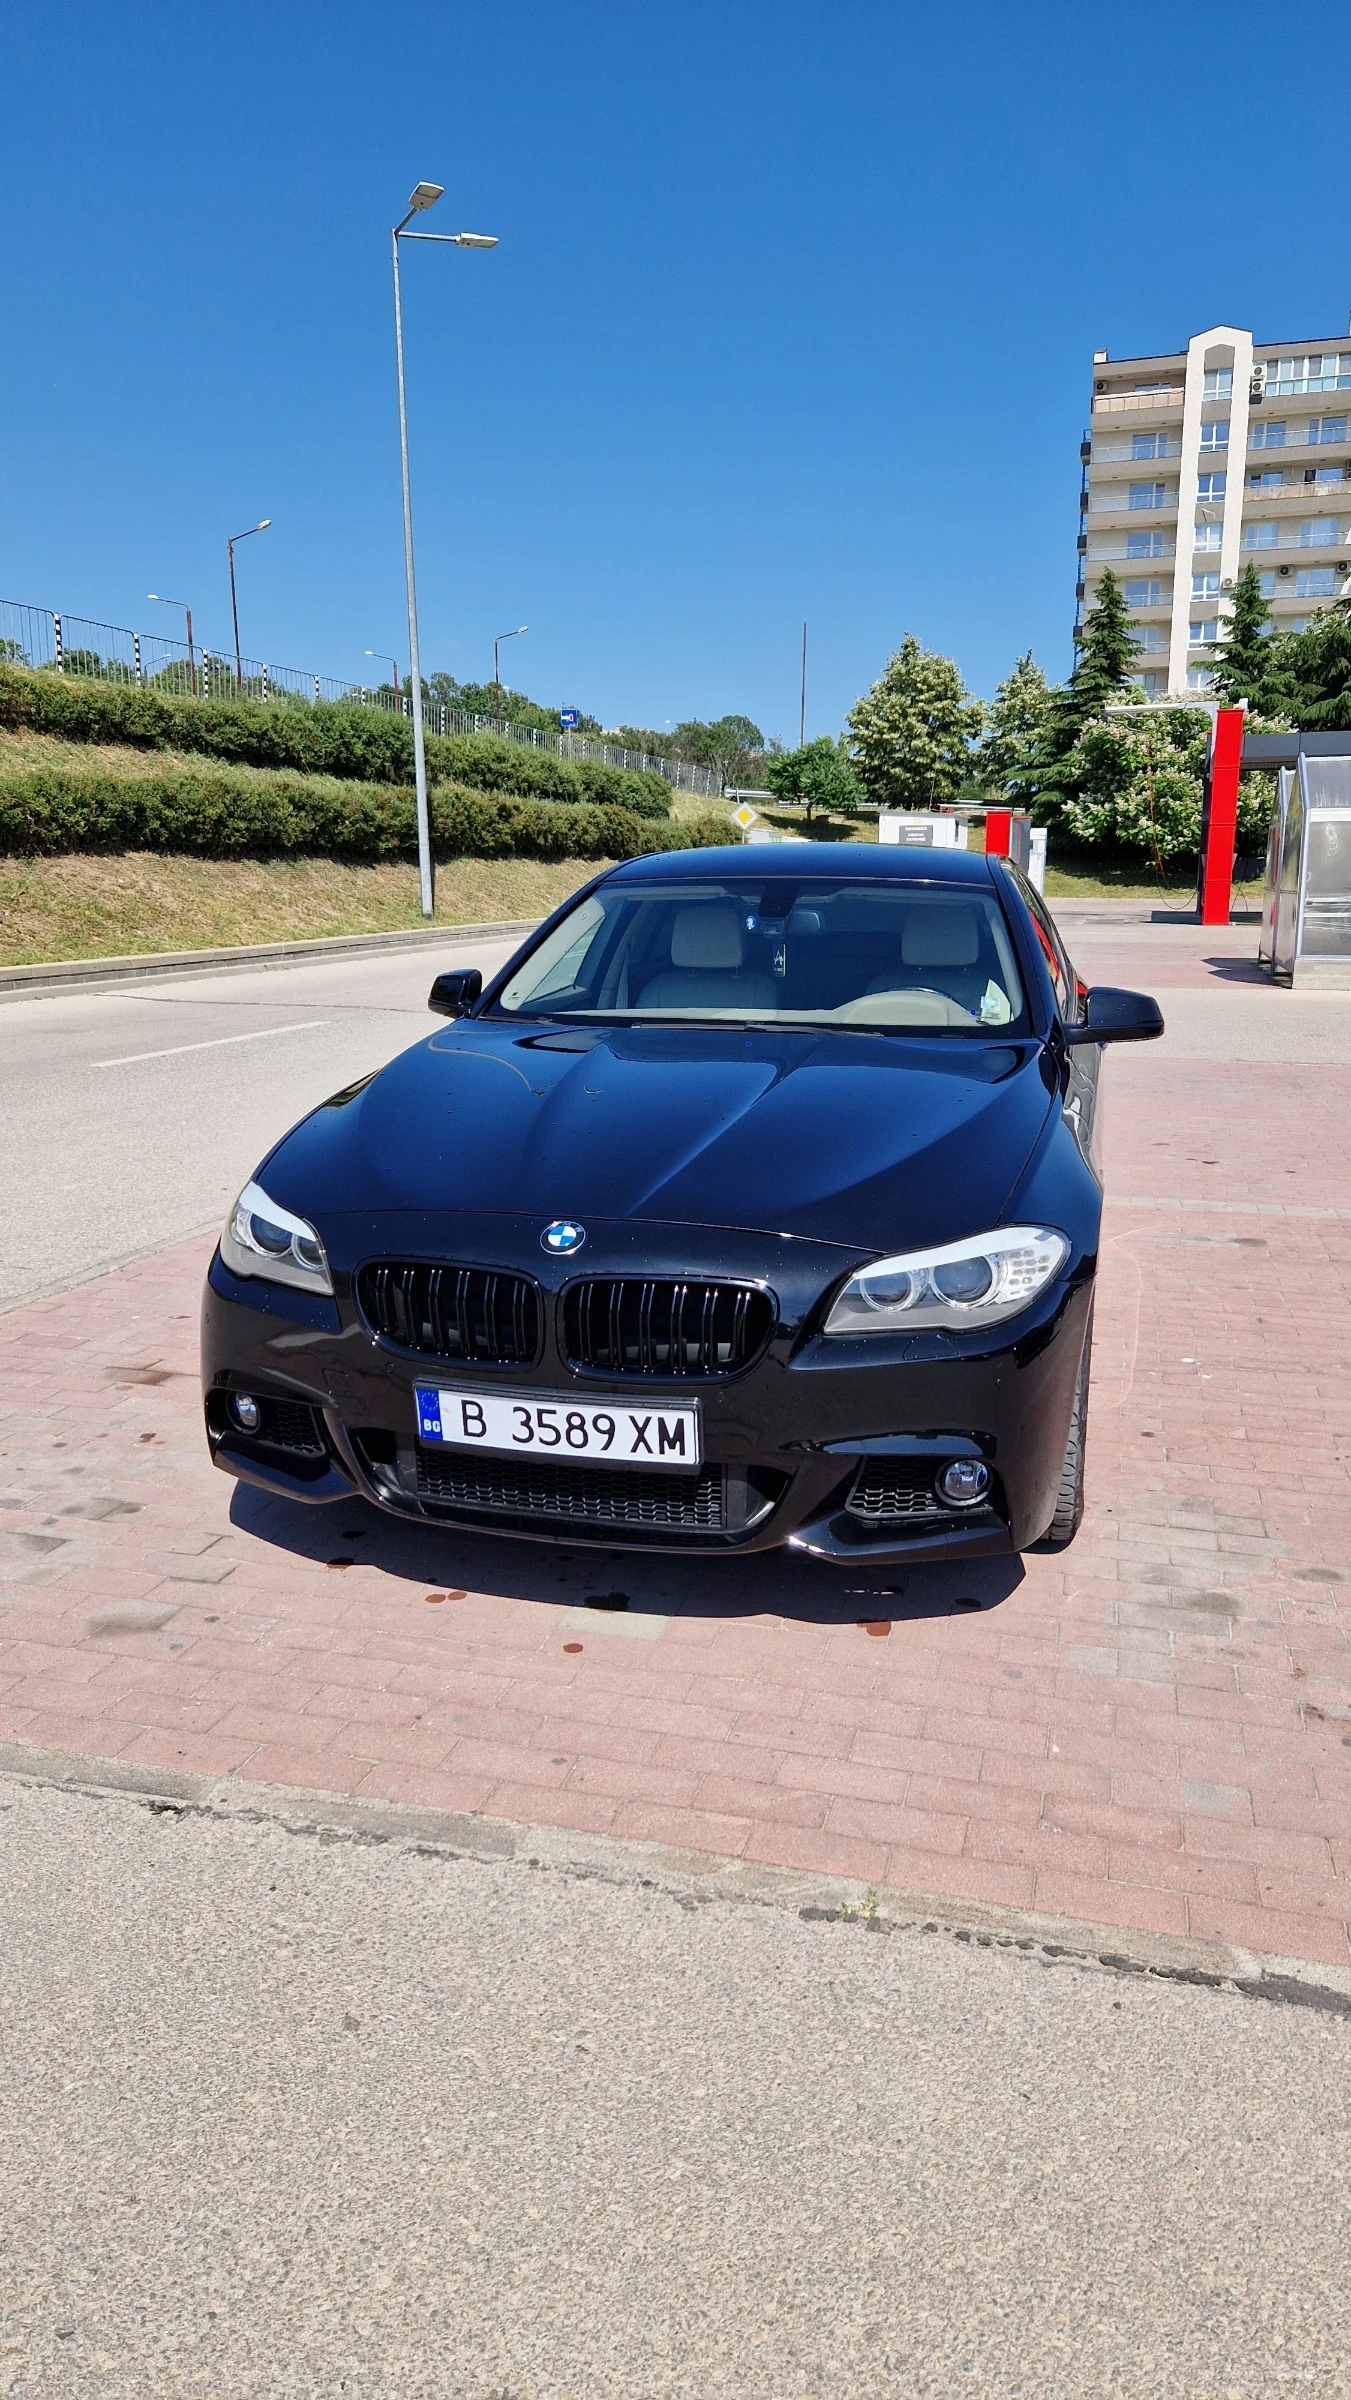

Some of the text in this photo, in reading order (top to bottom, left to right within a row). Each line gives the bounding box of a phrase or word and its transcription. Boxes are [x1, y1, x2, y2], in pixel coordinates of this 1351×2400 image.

[423, 1418, 441, 1433] BG
[461, 1399, 686, 1456] B 3589 XM
